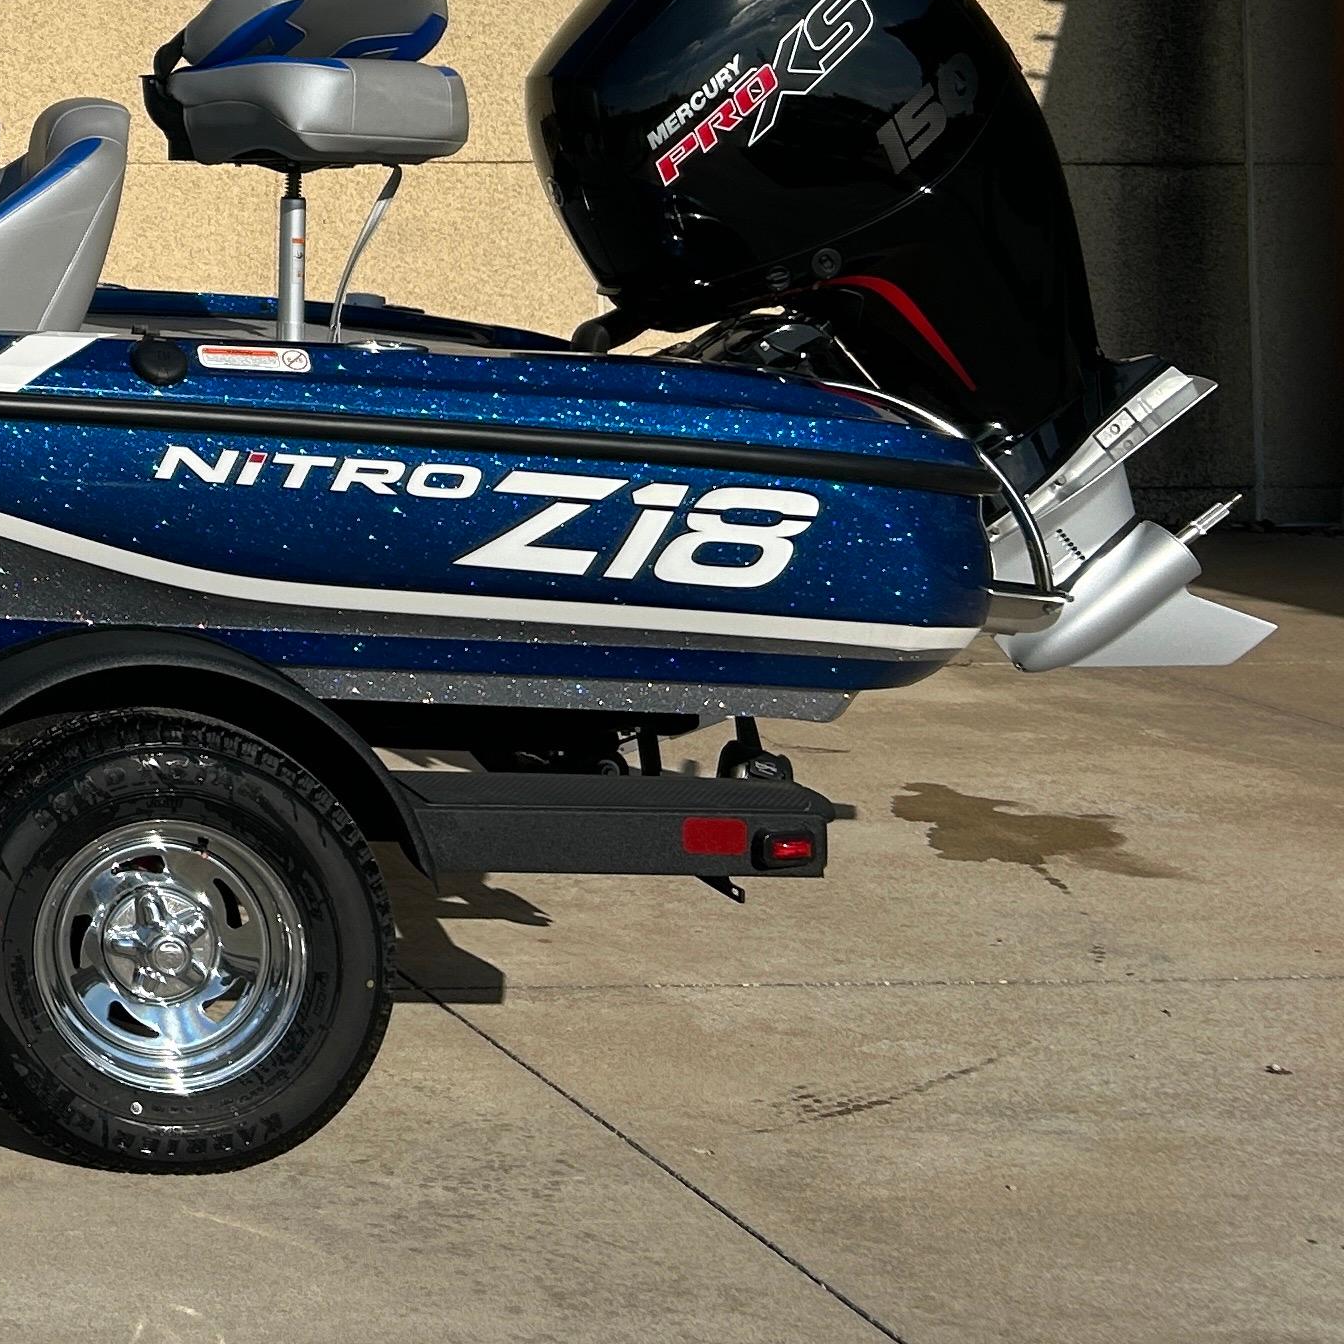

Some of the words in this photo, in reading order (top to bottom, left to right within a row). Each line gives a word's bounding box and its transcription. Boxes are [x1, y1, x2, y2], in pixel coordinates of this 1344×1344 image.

[646, 53, 742, 151] MERCURY
[655, 63, 779, 187] PRO
[452, 470, 820, 588] Z18
